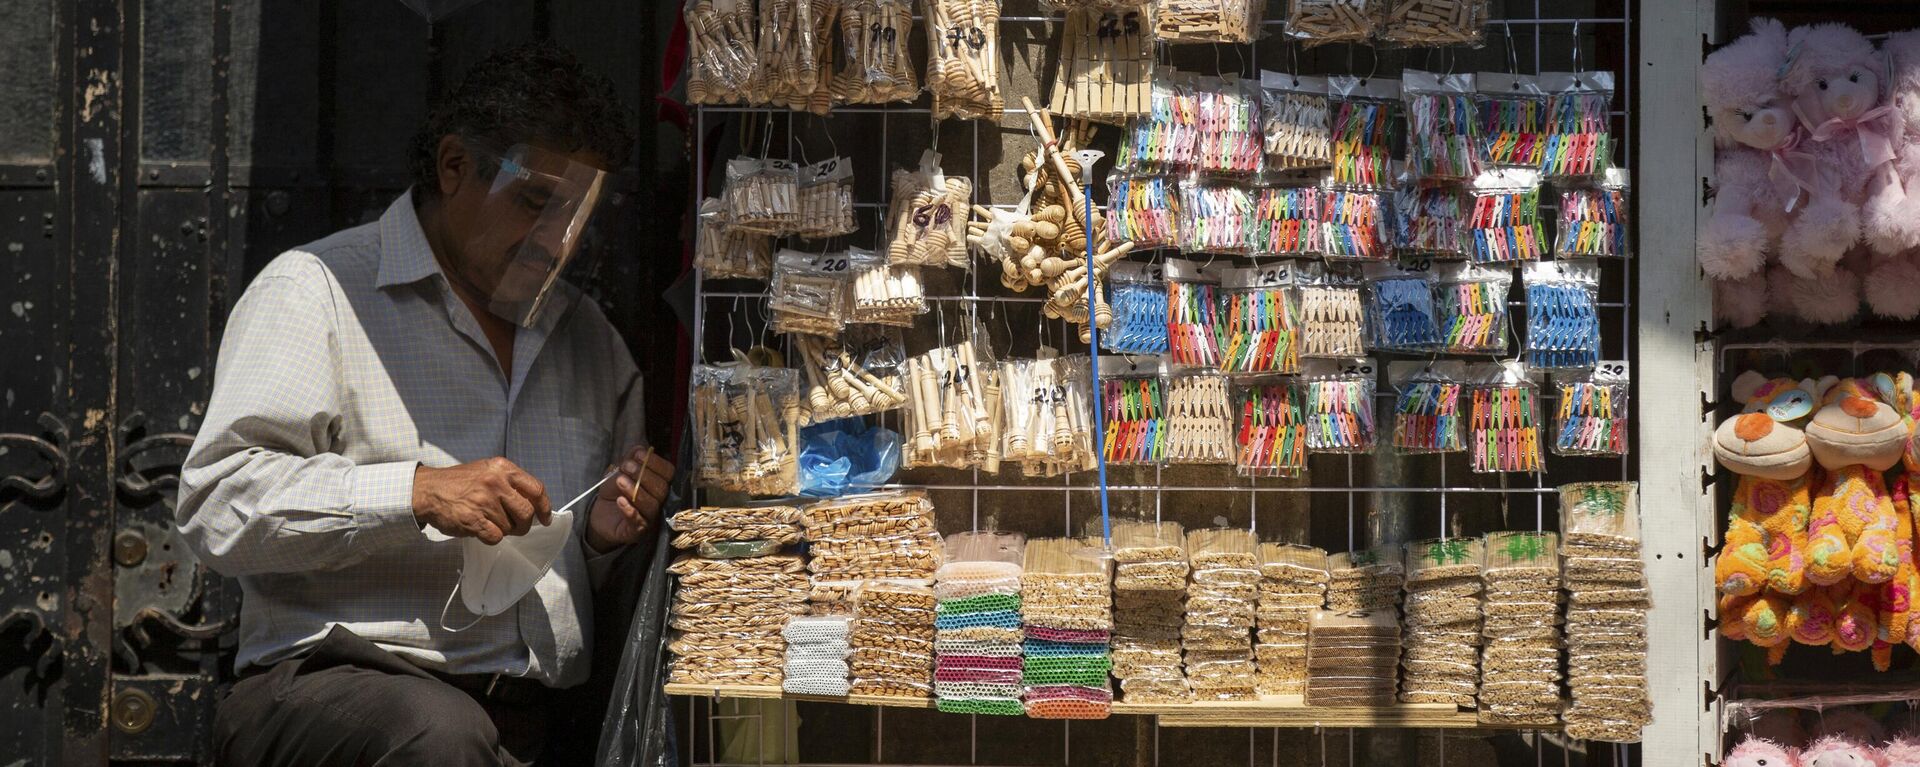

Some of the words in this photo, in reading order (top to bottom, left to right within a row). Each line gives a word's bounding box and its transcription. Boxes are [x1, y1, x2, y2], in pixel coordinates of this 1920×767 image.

[817, 160, 837, 177] 20
[912, 203, 951, 228] 60
[822, 258, 847, 272] 20
[1405, 259, 1431, 272] 20
[1263, 269, 1289, 284] 20
[1344, 365, 1373, 375] 20
[1601, 363, 1625, 376] 20
